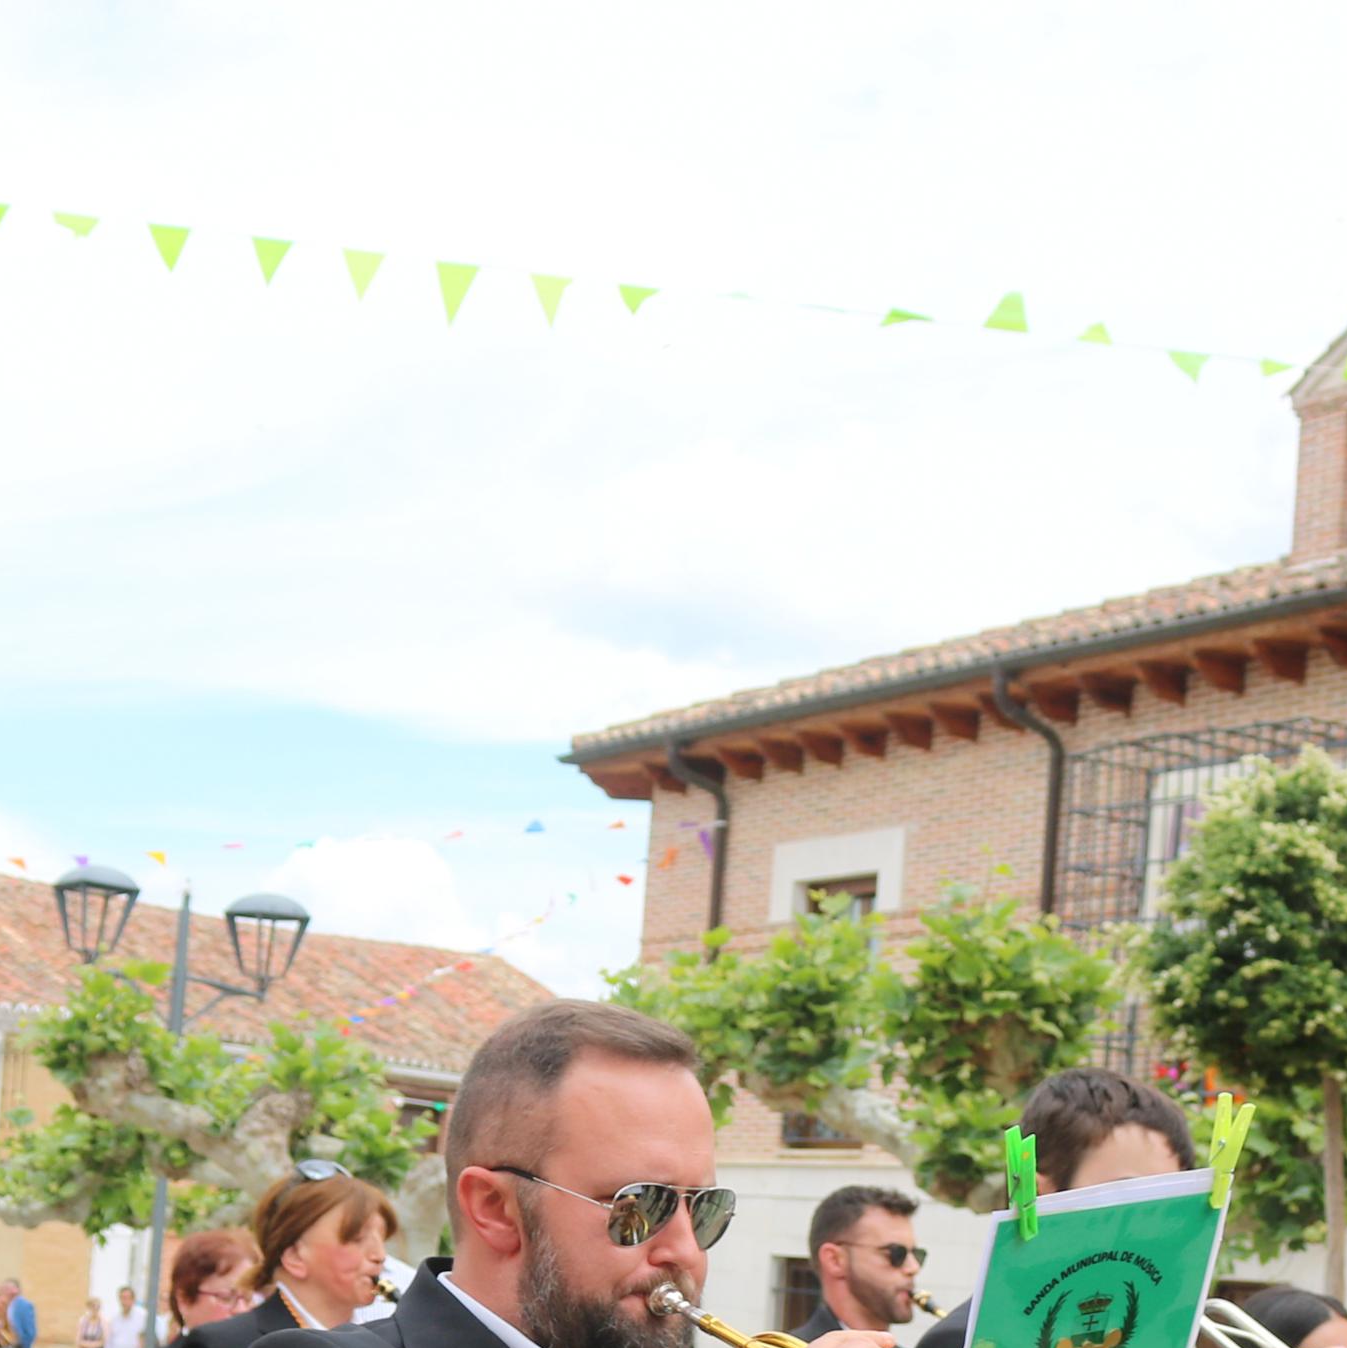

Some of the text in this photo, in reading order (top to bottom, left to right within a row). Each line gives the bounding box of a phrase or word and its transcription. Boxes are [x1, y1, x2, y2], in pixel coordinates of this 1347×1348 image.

[1023, 1278, 1060, 1316] BANDA
[1060, 1250, 1119, 1280] MUNICIPAL
[1120, 1250, 1135, 1263] DE
